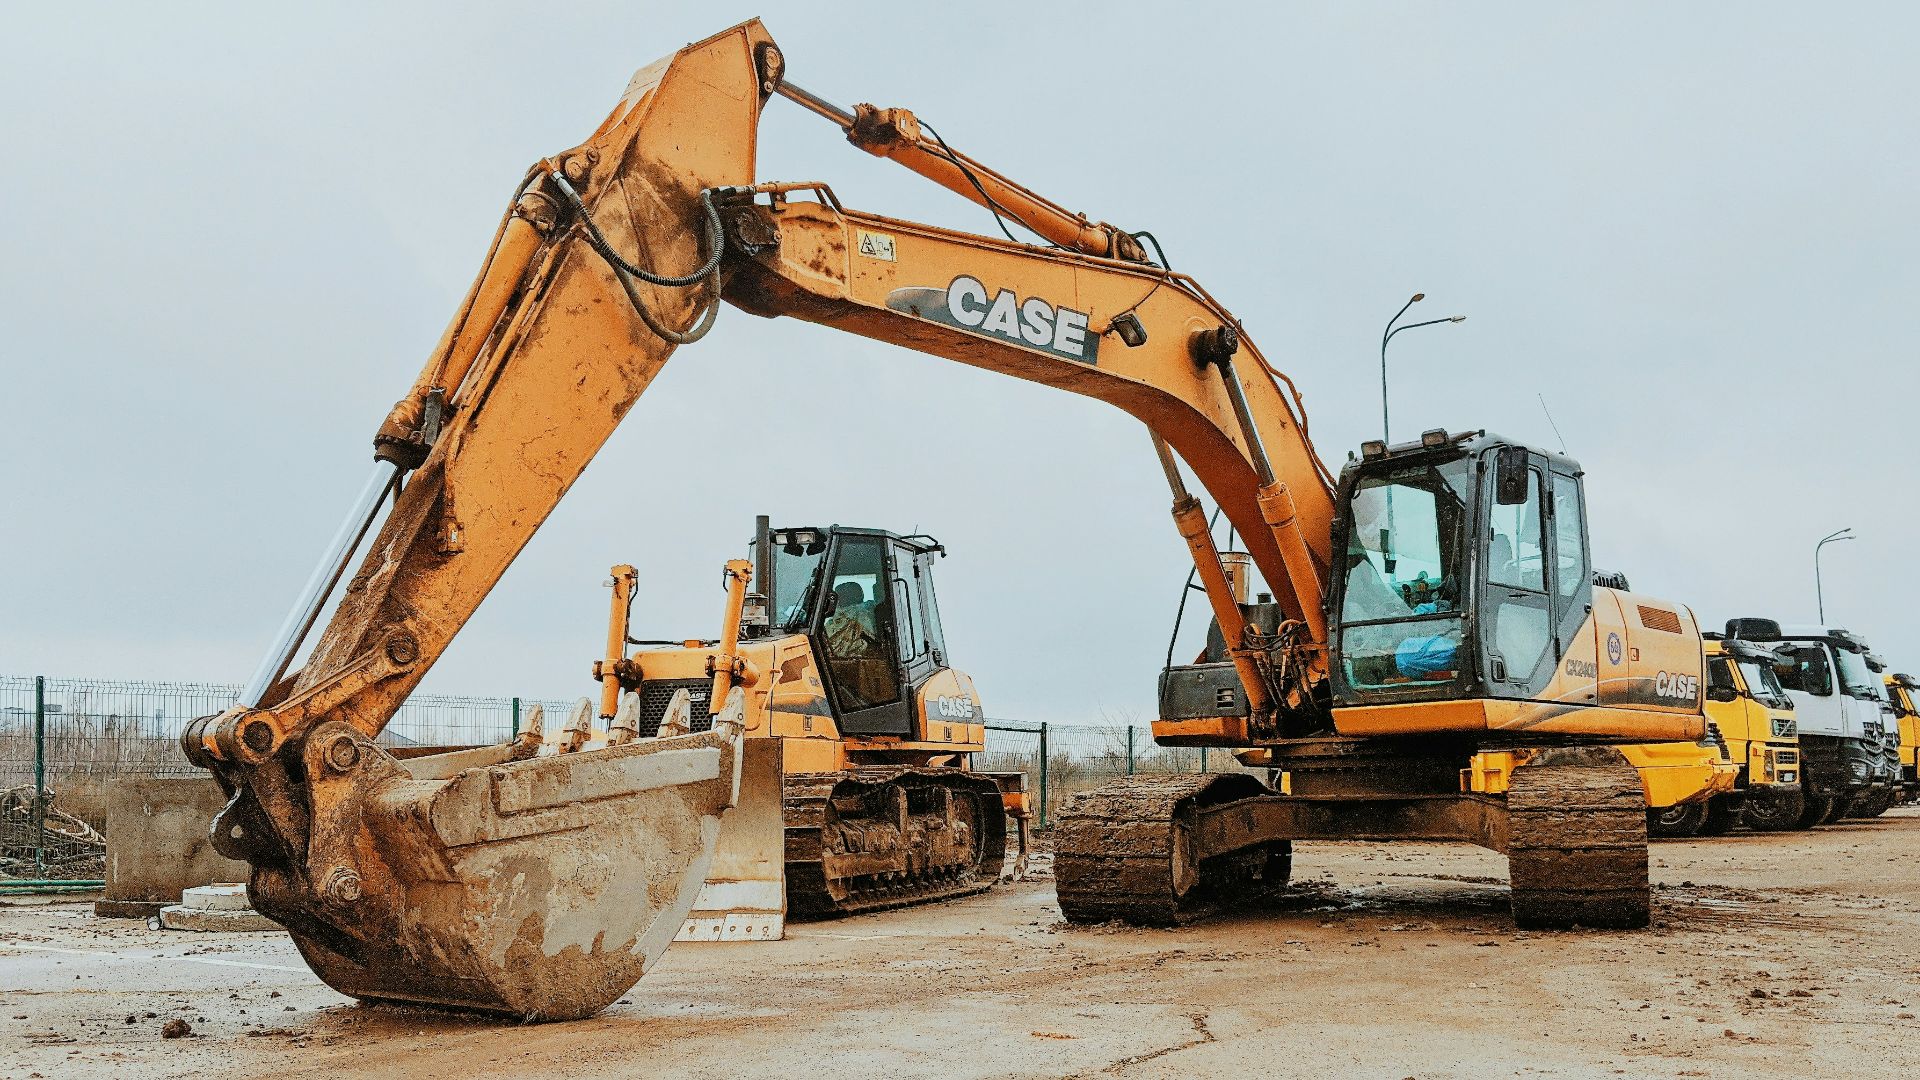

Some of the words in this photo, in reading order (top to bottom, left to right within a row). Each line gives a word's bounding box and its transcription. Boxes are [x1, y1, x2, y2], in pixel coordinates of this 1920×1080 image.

[947, 275, 1088, 356] CASE
[1656, 670, 1697, 700] CASE
[938, 695, 972, 718] CASE
